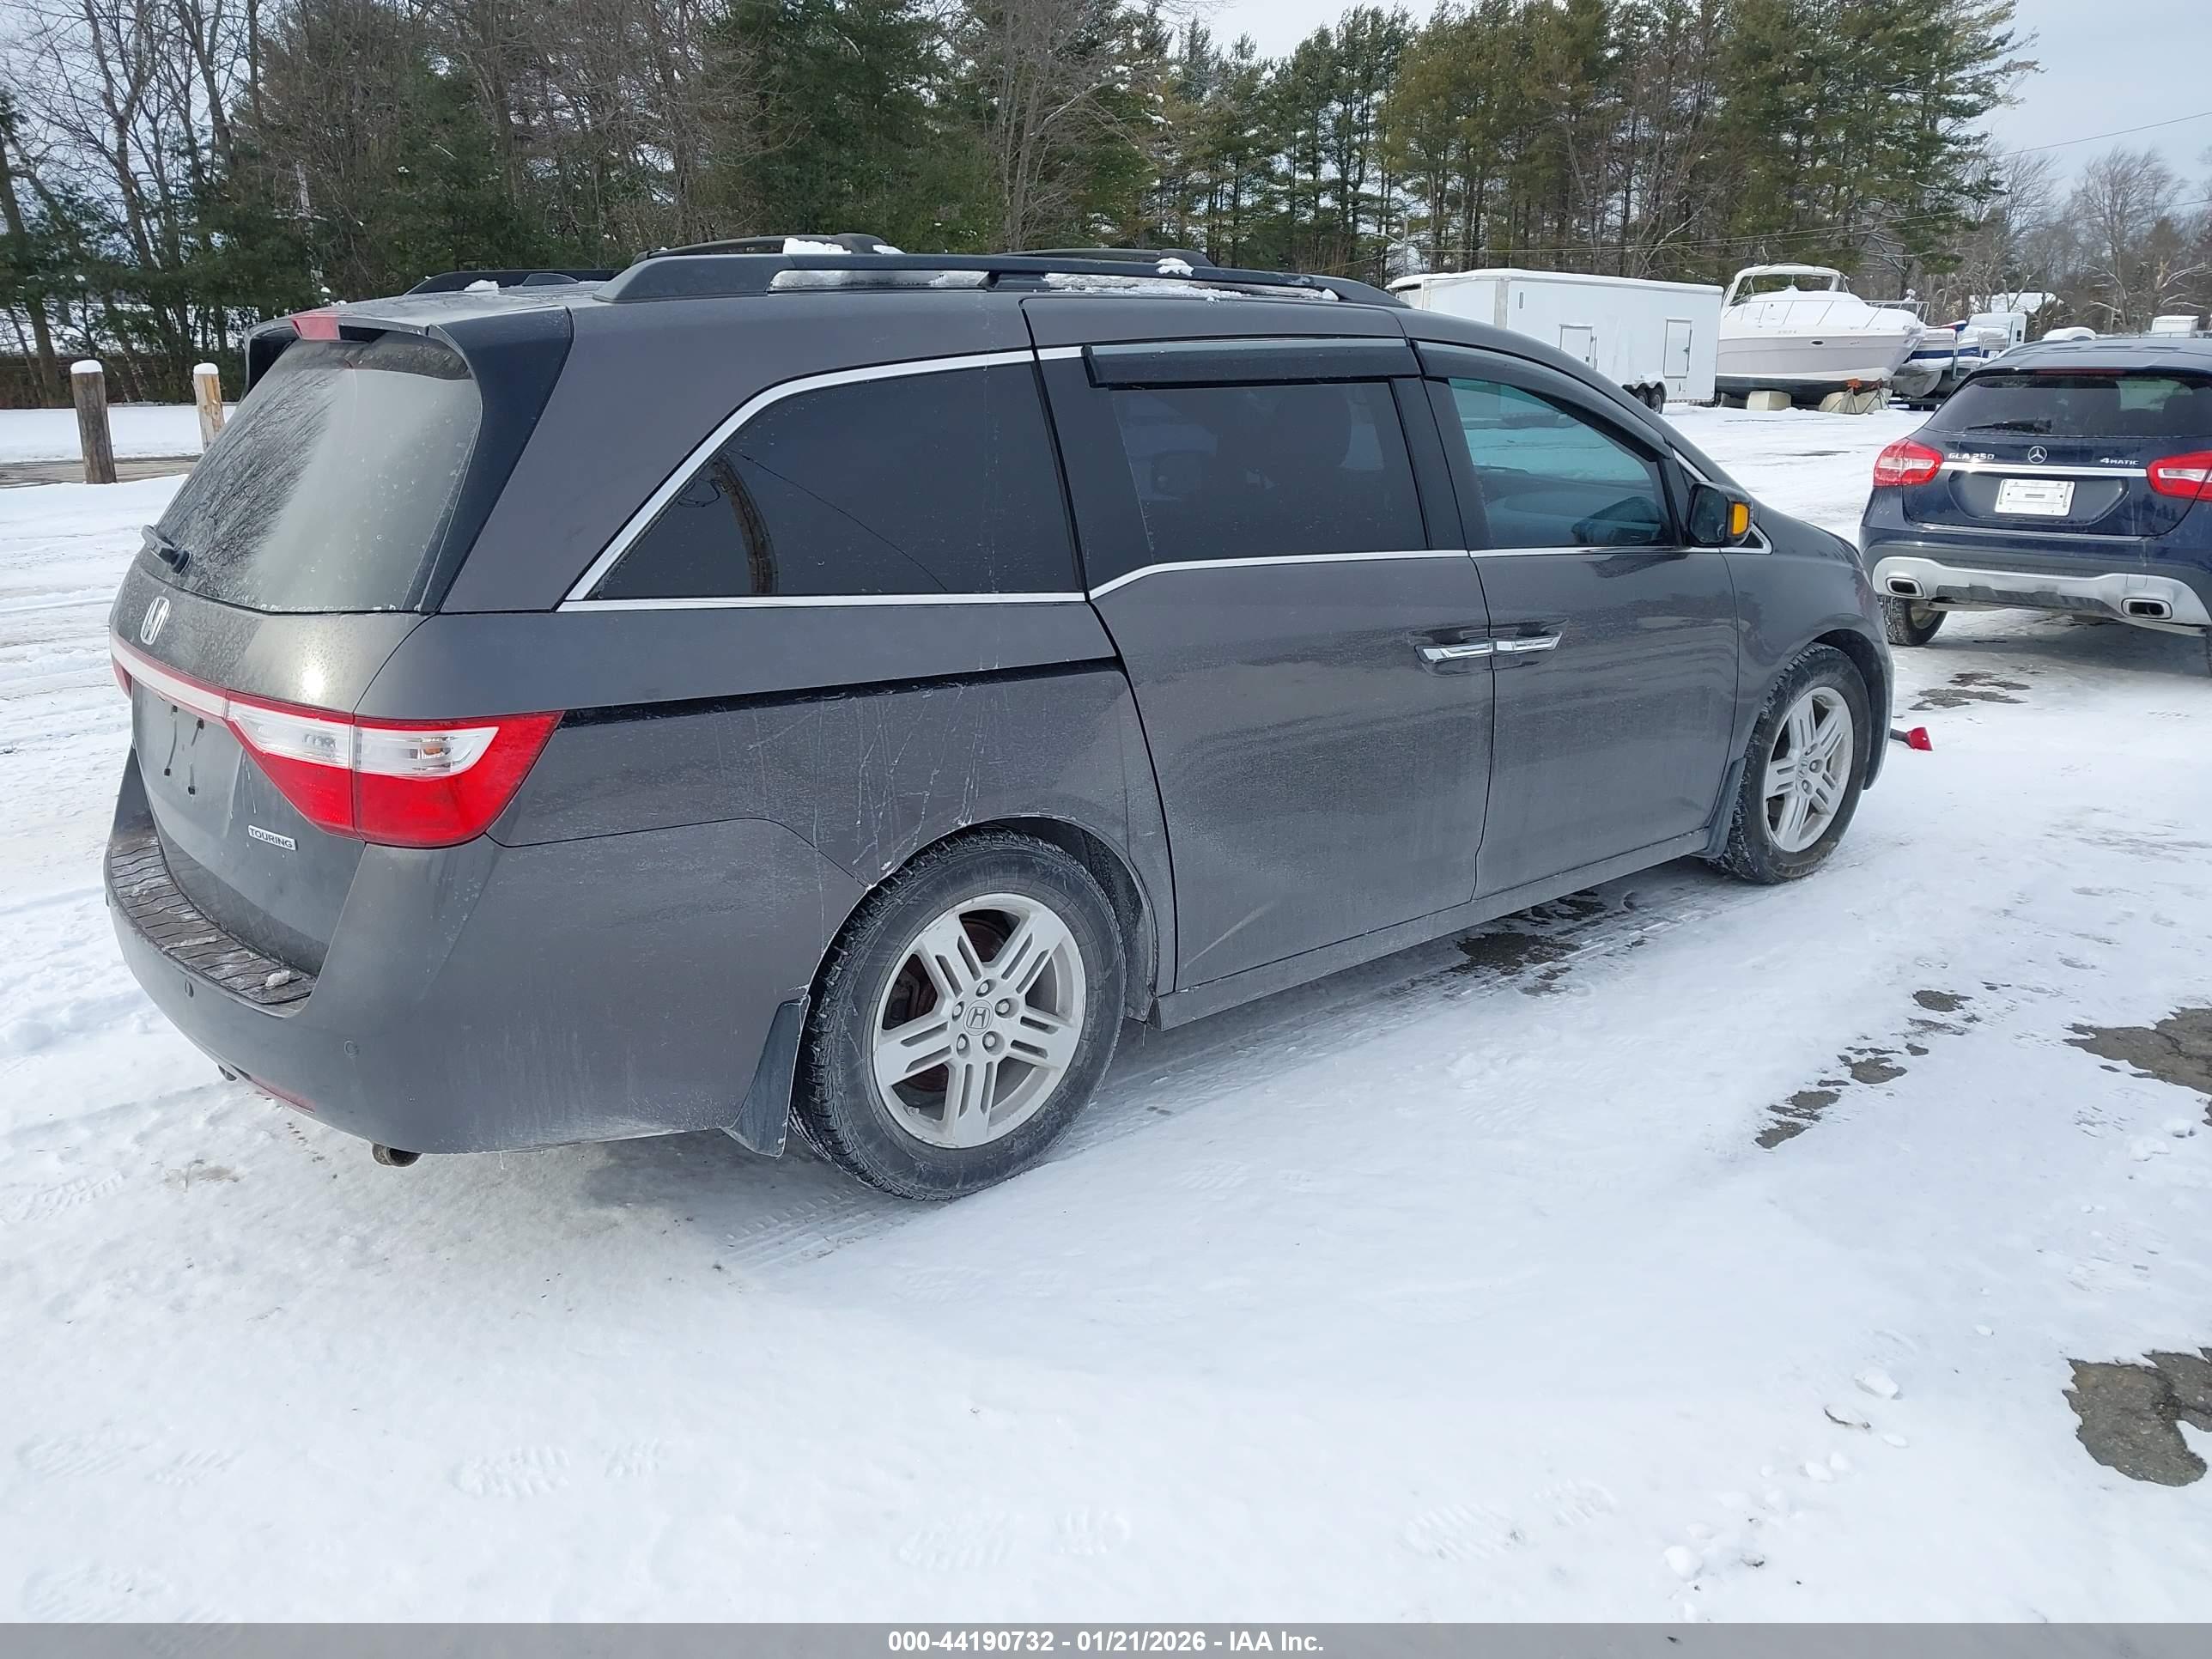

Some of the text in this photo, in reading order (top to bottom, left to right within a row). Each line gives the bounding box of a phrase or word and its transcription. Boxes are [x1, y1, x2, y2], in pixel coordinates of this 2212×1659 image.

[1972, 453, 1995, 461] 250
[2100, 457, 2139, 465] 4MATIC
[249, 827, 294, 848] TOURING
